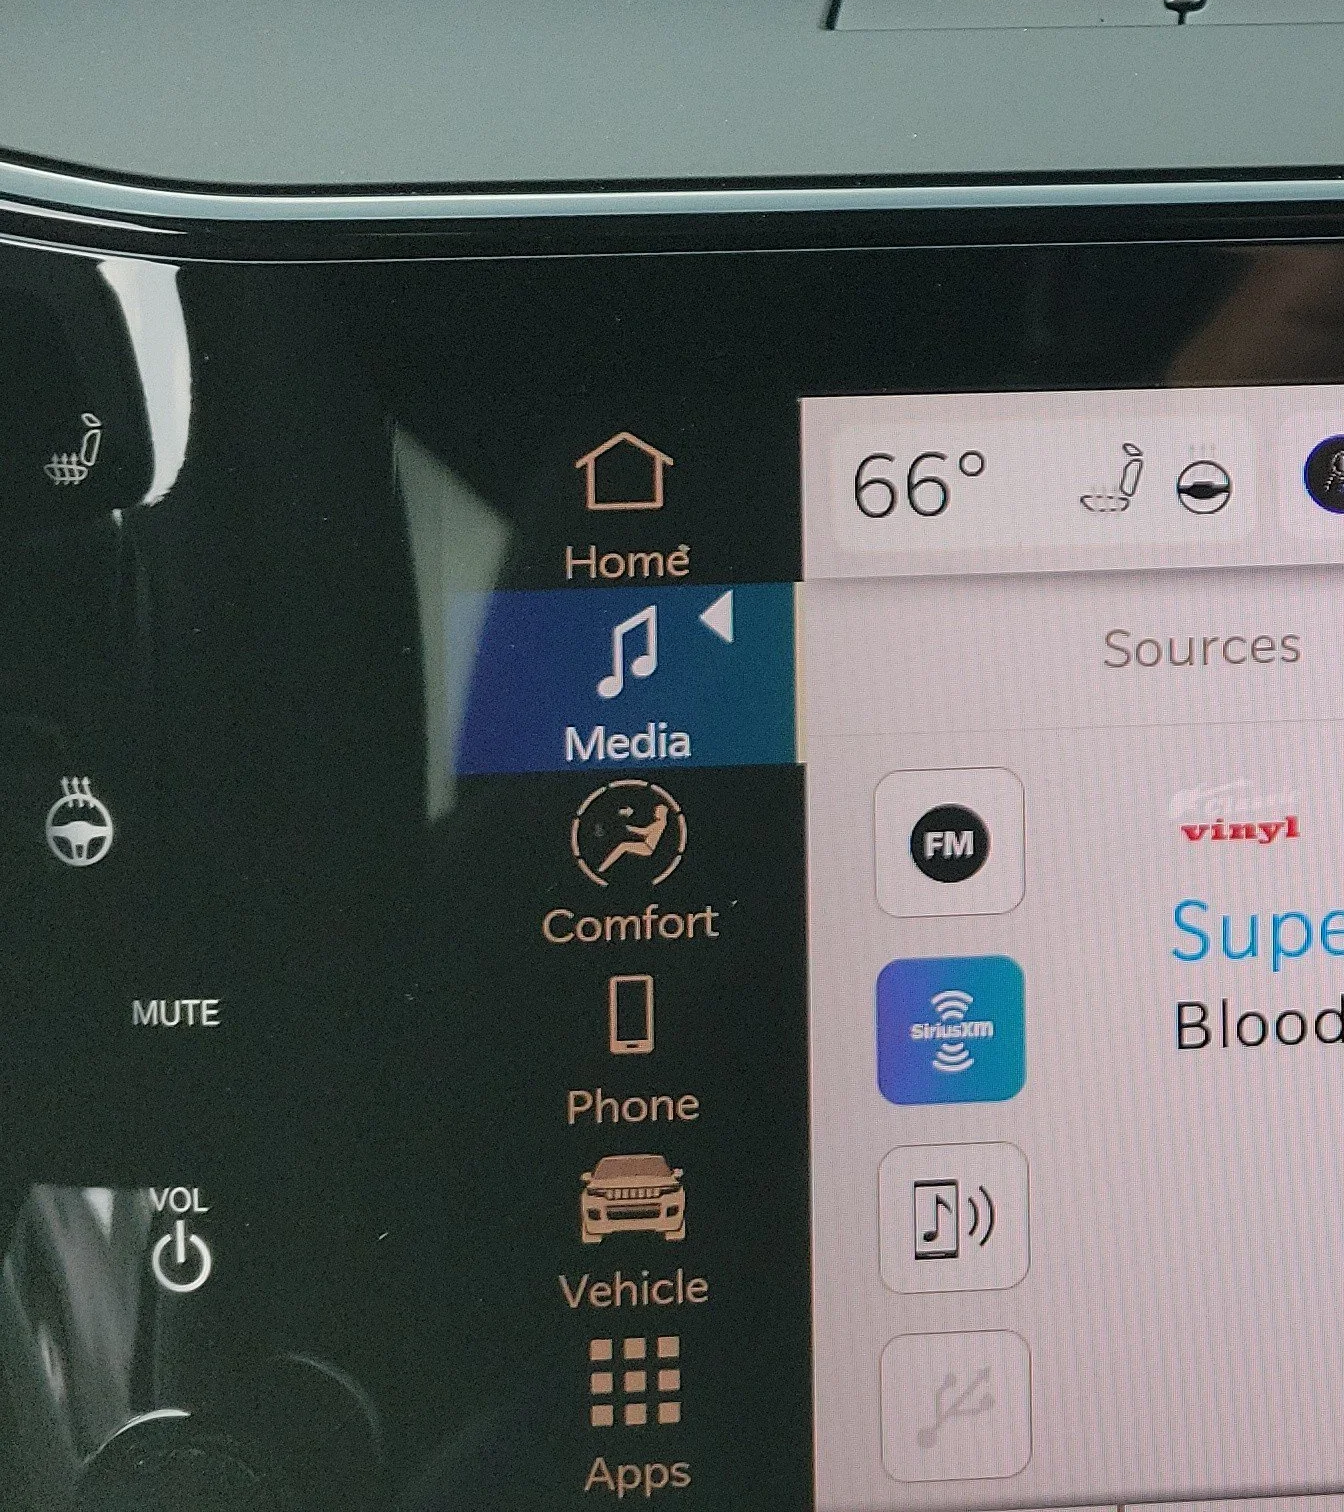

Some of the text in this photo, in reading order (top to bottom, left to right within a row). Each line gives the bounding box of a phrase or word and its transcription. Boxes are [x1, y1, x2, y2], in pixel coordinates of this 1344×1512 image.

[563, 544, 692, 580] Home
[1102, 627, 1303, 671] Sources
[563, 722, 692, 762] Media
[922, 829, 975, 859] FM
[1180, 814, 1301, 845] vinyl
[541, 903, 721, 946] Comfort
[131, 998, 222, 1028] MUTE
[566, 1088, 701, 1125] Phone
[150, 1186, 209, 1213] VOL
[558, 1268, 709, 1309] Vehicle
[584, 1456, 693, 1498] Apps
